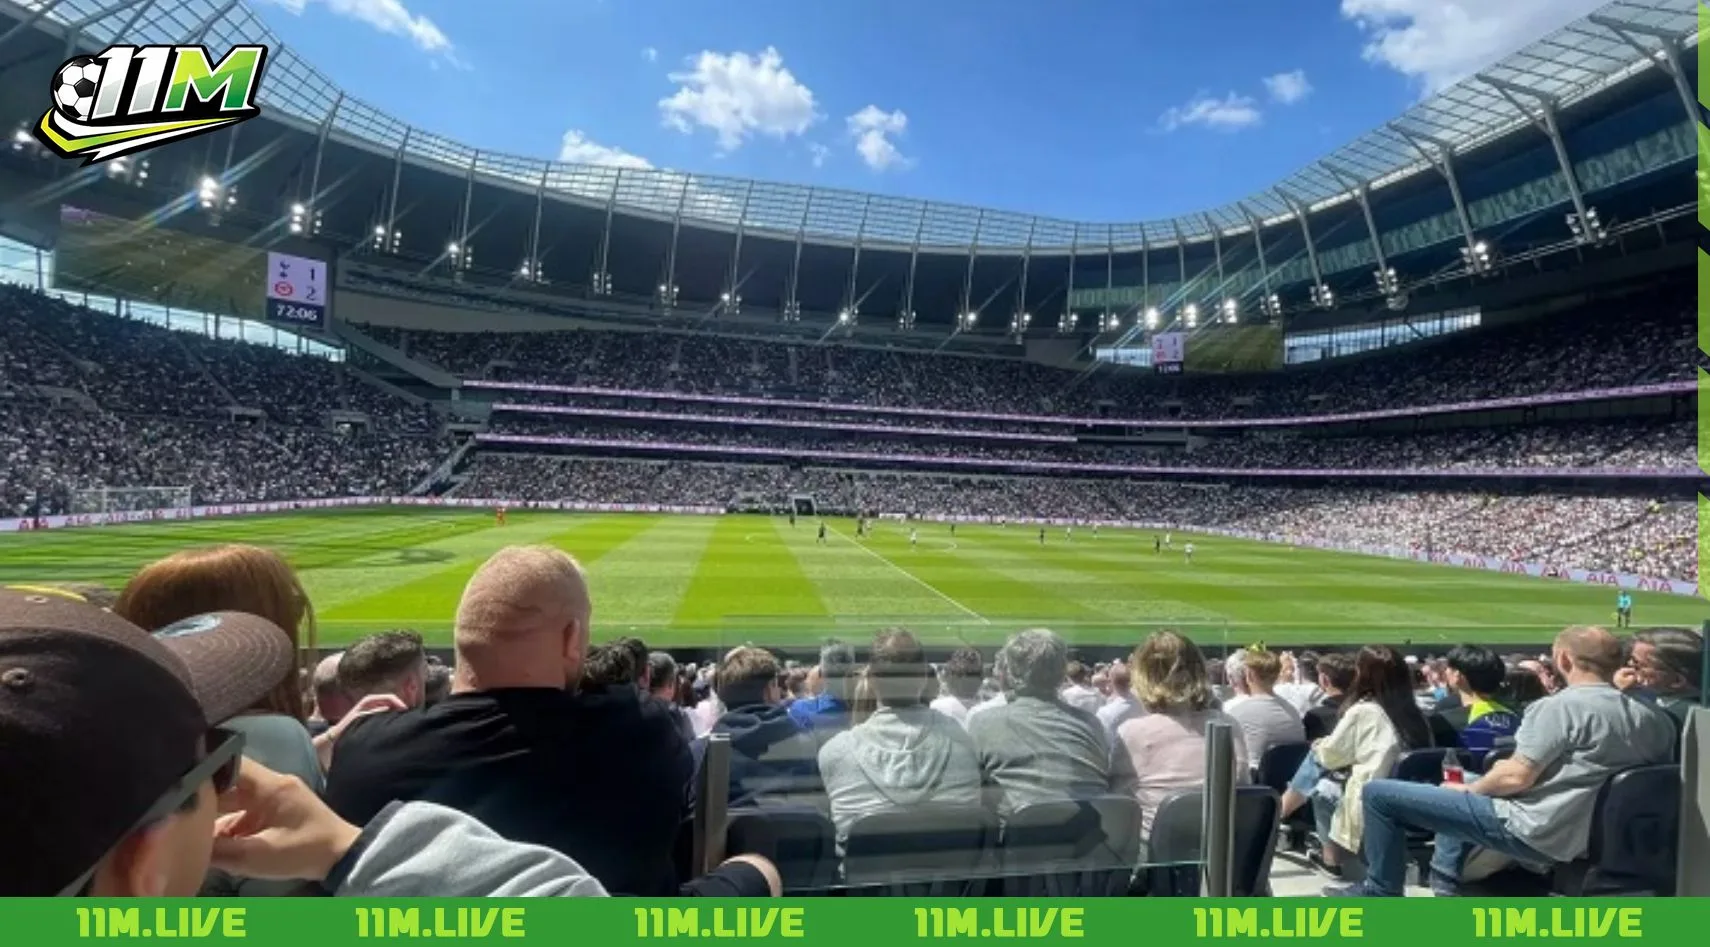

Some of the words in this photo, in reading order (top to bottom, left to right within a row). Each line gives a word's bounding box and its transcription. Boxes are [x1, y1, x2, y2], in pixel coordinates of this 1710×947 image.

[306, 286, 316, 301] 2
[1586, 572, 1619, 586] AIA
[1637, 576, 1672, 594] AIA
